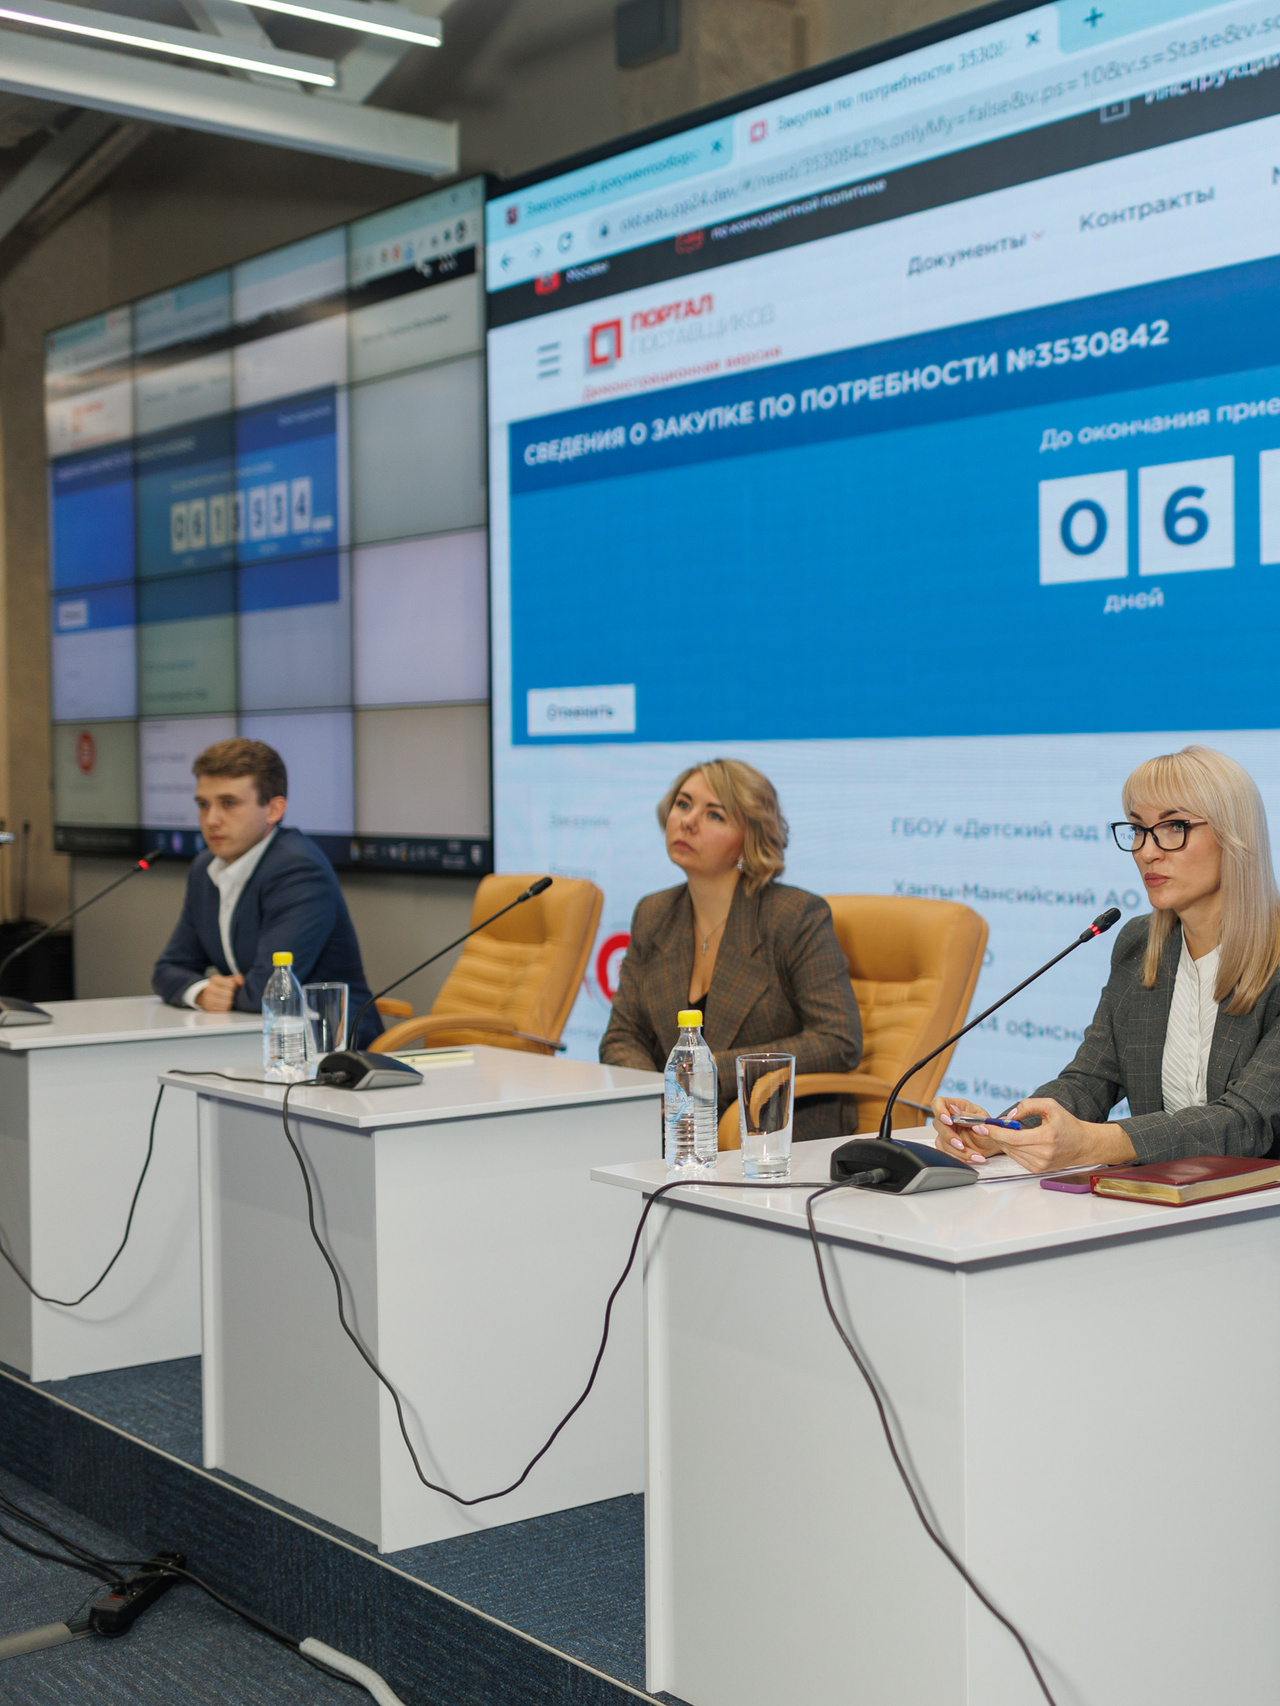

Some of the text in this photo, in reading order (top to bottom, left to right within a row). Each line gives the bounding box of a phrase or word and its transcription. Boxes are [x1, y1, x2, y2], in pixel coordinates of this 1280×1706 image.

[906, 231, 1027, 277] Документы
[1079, 186, 1215, 233] Контракты
[629, 303, 776, 356] ПОСТАВЩИКОВ
[631, 293, 714, 333] ПОРТАЛ
[524, 318, 1170, 465] СВЕДЕНИЯ О ЗАКУПКЕ ПО ПОТРЕБНОСТИ №3530842
[1039, 427, 1073, 454] До
[1078, 405, 1210, 447] окончания
[1104, 586, 1165, 615] дней
[891, 817, 947, 837] ГБОУ
[954, 818, 1053, 839] «Детский
[1059, 823, 1099, 842] сад
[1104, 889, 1142, 910] АО
